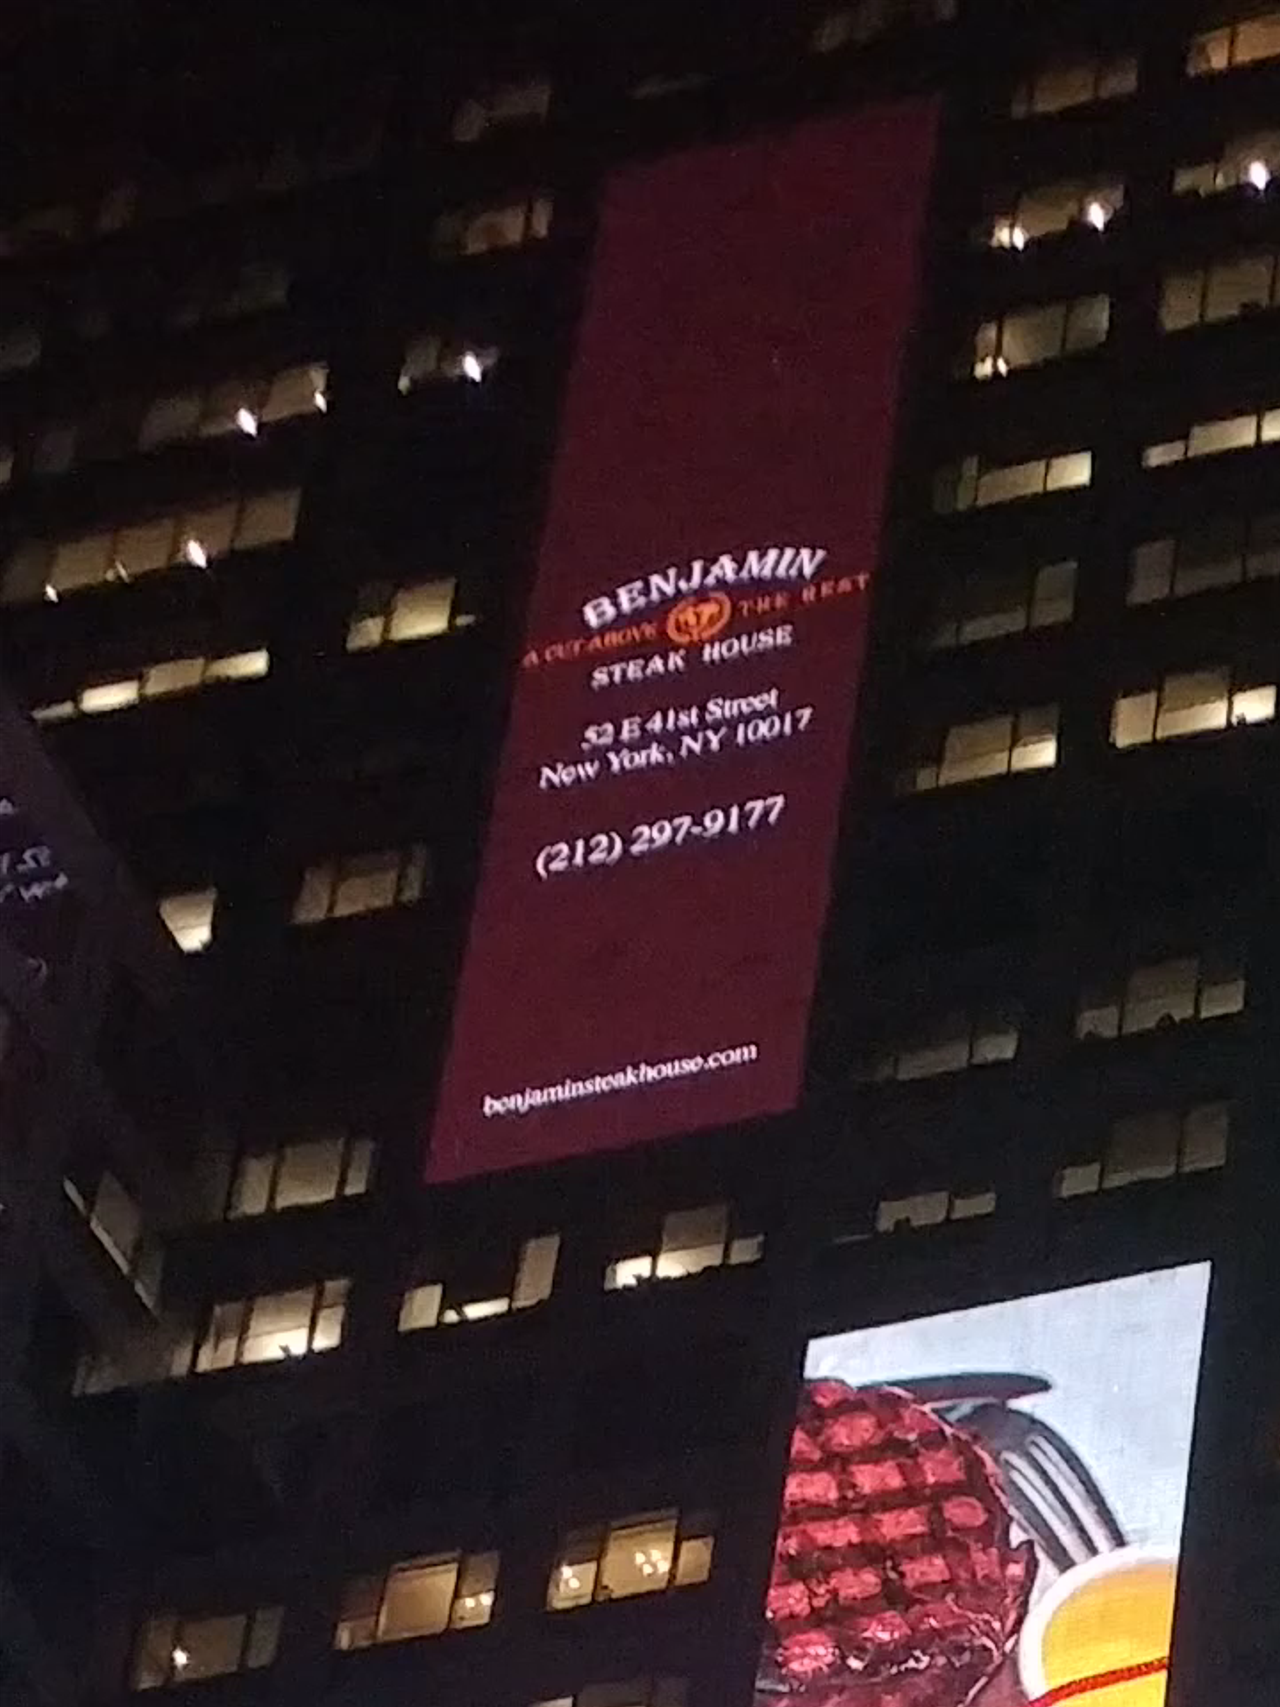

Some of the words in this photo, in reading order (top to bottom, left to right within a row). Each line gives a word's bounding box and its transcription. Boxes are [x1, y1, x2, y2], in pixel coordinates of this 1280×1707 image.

[583, 547, 827, 629] BENJAMIN
[591, 648, 687, 690] STEAK
[702, 625, 793, 664] HOUSE
[539, 759, 600, 790] New
[606, 743, 675, 775] York,
[680, 726, 727, 758] NY
[736, 706, 814, 746] 10017
[581, 721, 614, 751] 52
[621, 717, 642, 740] E
[645, 704, 699, 734] 41st
[705, 687, 779, 723] Street
[535, 832, 624, 880] (212)
[629, 794, 786, 857] 297-9177
[482, 1043, 759, 1117] benjaminsteakhouse.com
